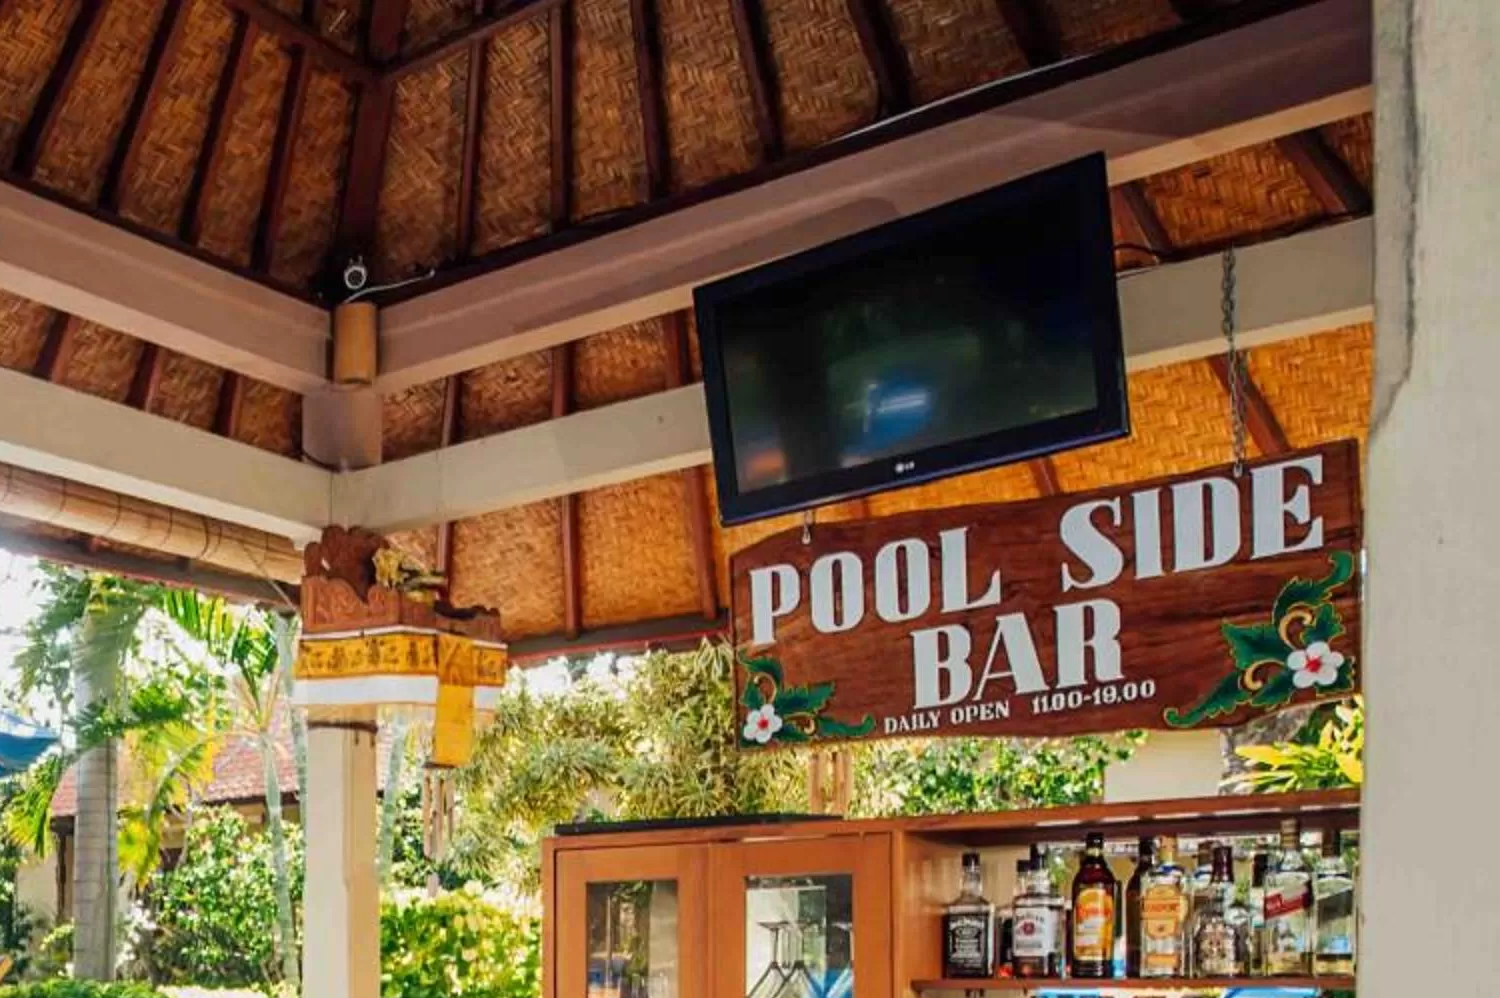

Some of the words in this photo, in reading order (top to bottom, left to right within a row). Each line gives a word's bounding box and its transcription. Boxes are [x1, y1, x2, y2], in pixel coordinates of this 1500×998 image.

[749, 526, 1002, 646] POOL
[1059, 454, 1325, 592] SIDE
[910, 599, 1126, 711] BAR
[884, 711, 941, 734] DAILY
[951, 700, 1010, 725] OPEN
